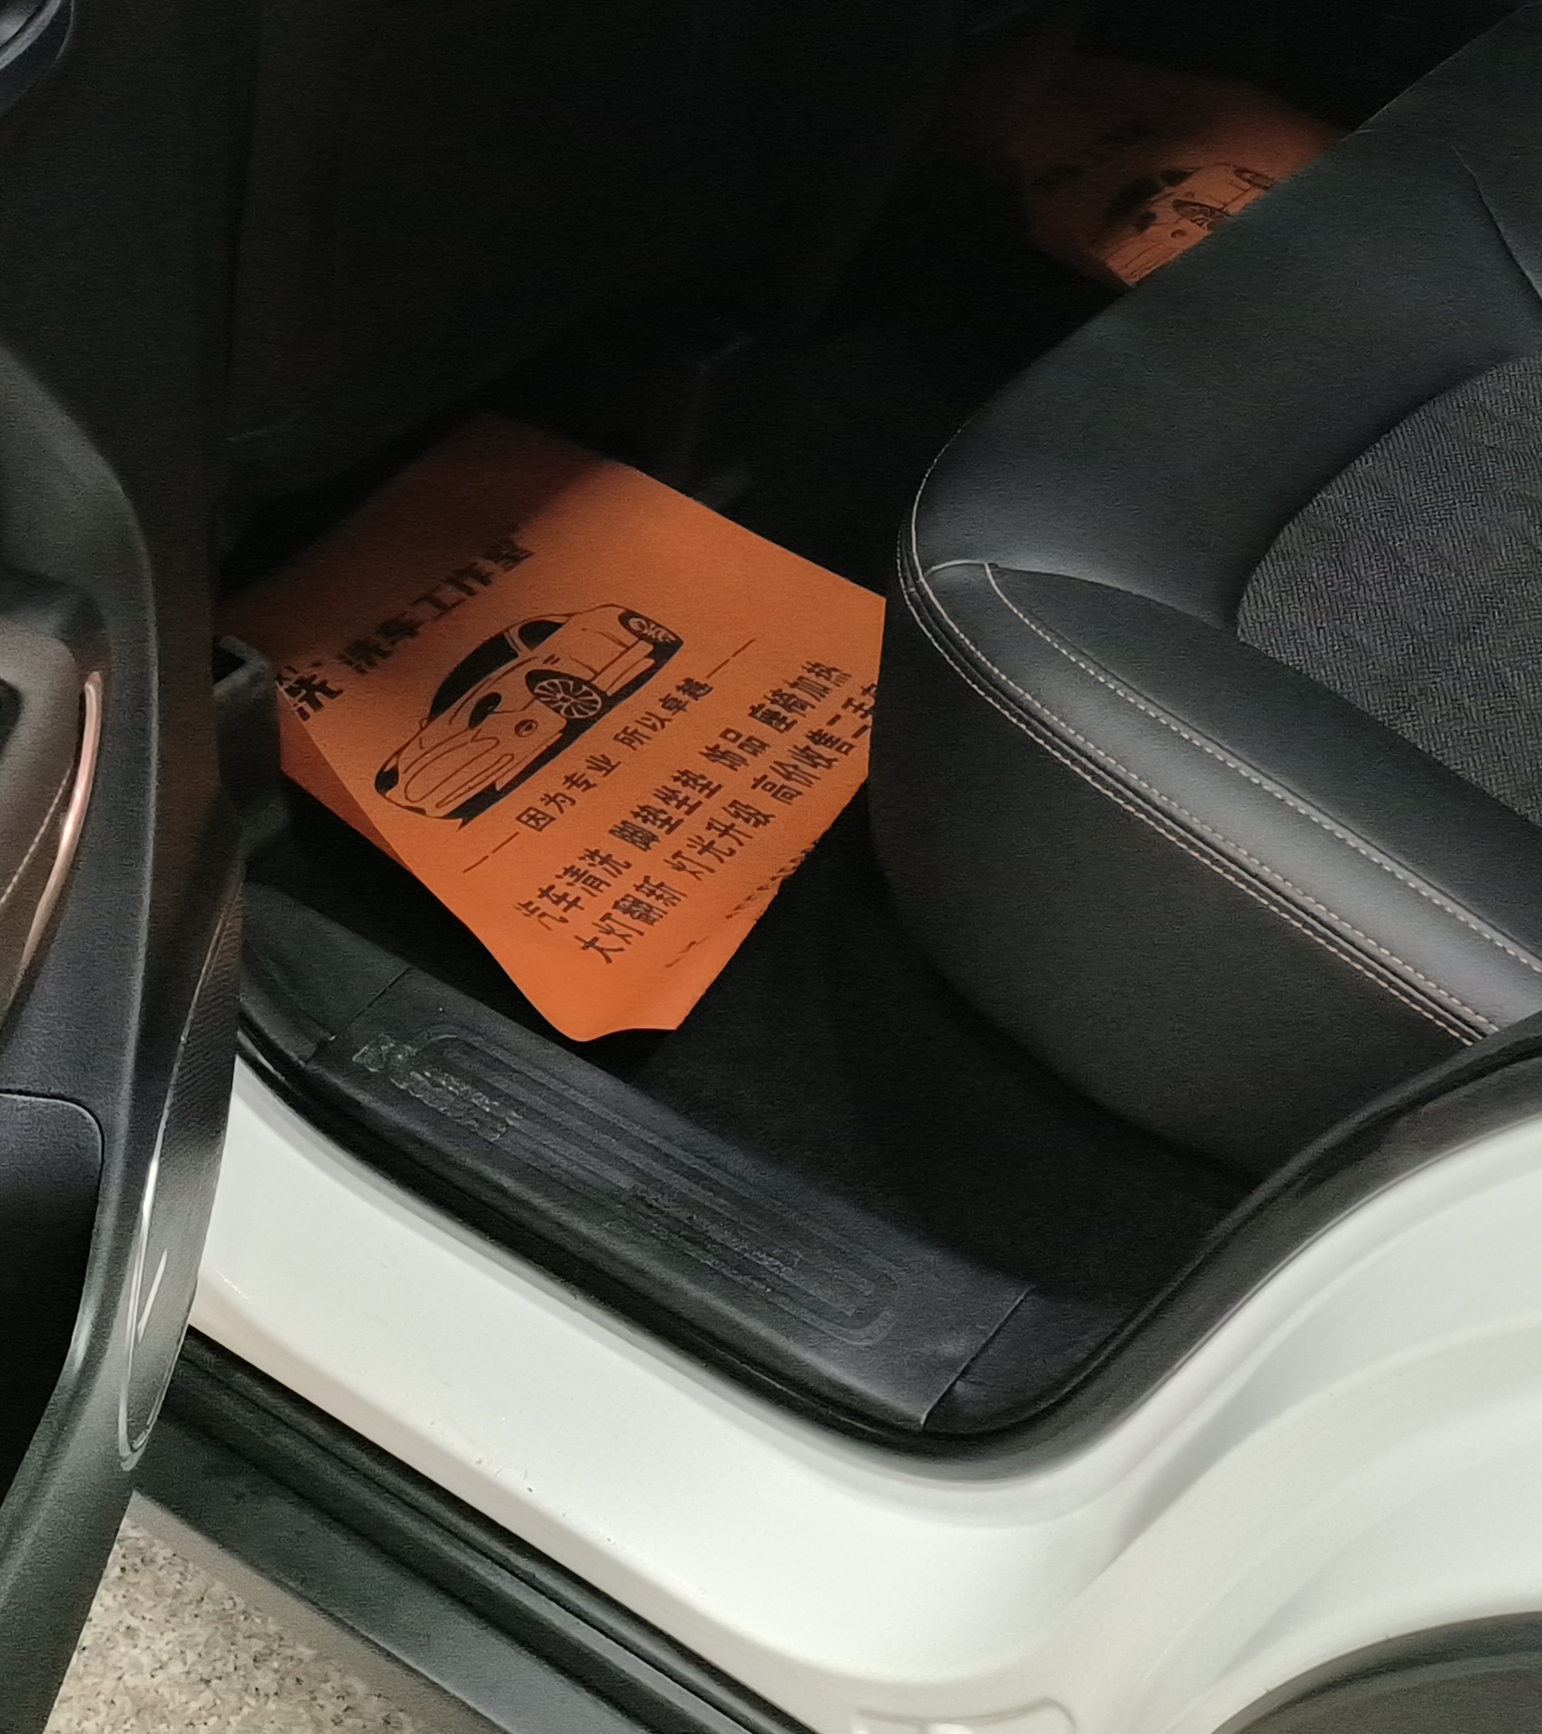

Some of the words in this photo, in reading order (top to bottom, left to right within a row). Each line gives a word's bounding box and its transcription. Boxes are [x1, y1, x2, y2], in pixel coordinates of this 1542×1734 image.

[515, 753, 622, 833] 因为专业
[613, 677, 715, 751] 所以卓越
[515, 847, 633, 931] 汽车清洗
[609, 769, 724, 852] 脚垫坐垫
[698, 727, 771, 772] 饰品
[748, 660, 853, 734] 座椅加热
[573, 874, 687, 964] 大灯翻新
[664, 799, 777, 882] 灯光升级
